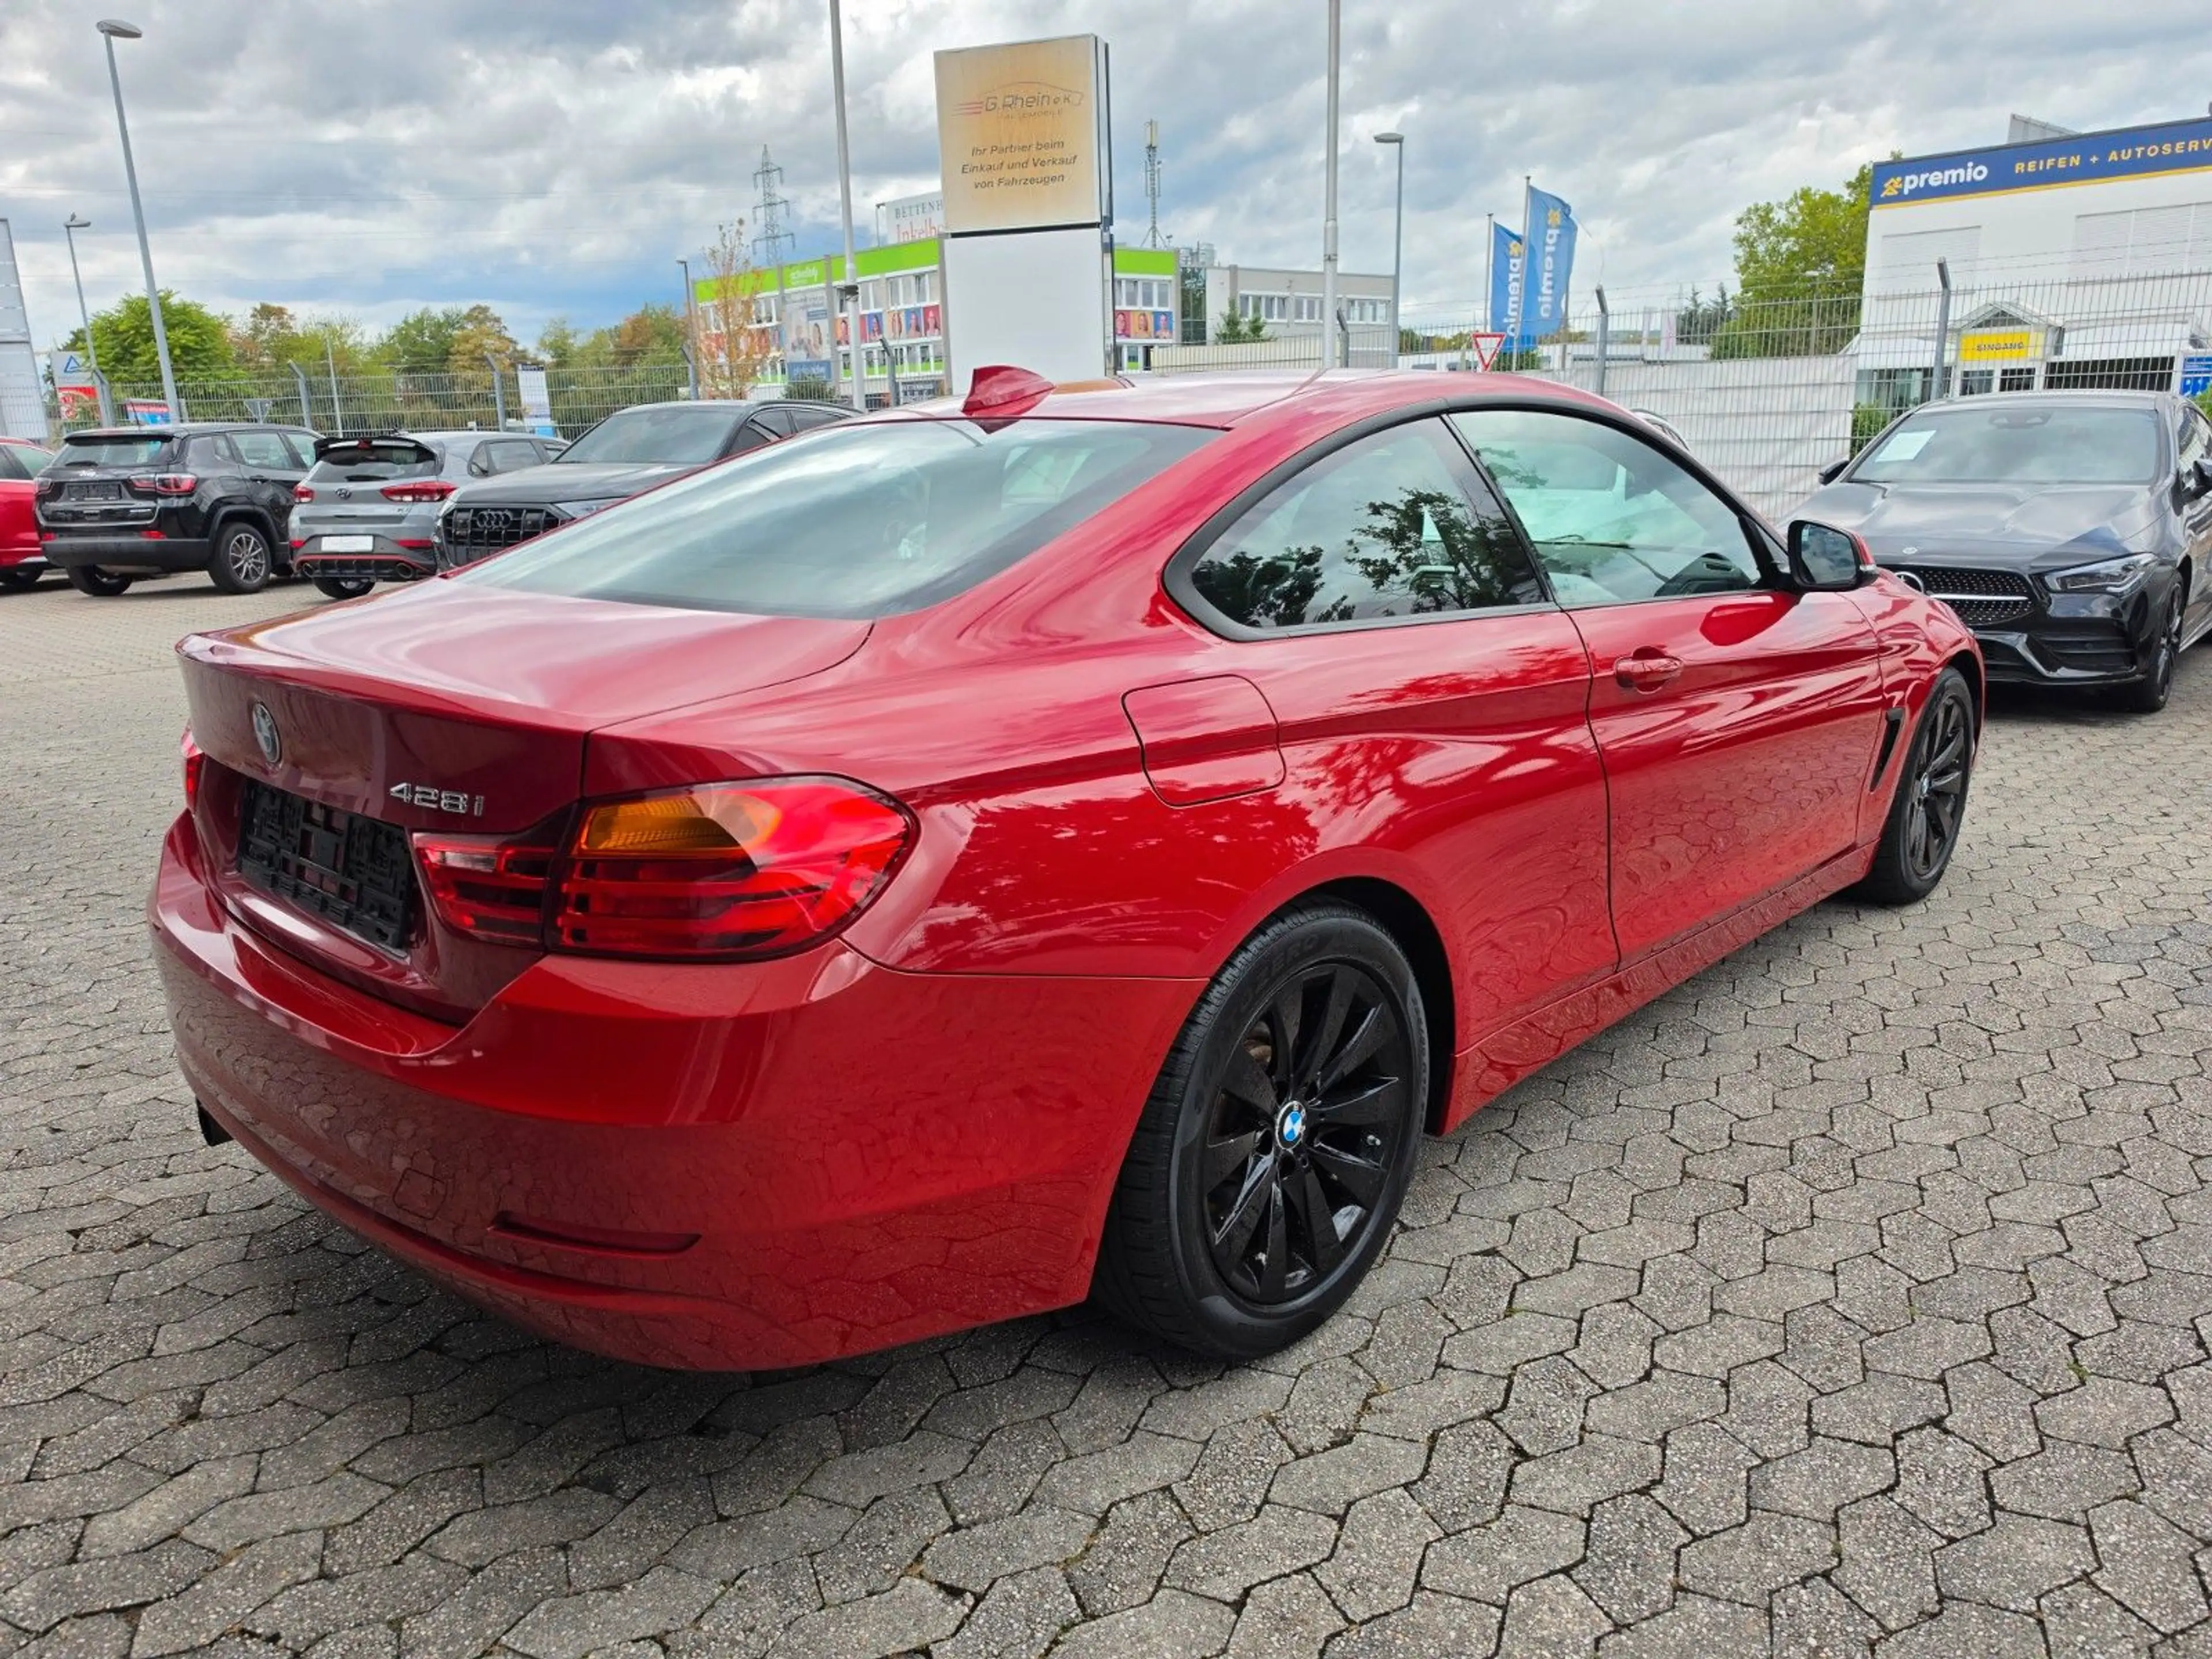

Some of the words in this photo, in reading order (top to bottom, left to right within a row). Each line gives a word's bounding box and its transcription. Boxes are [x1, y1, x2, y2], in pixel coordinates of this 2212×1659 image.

[971, 146, 987, 157] Ihr
[990, 142, 1032, 155] Partner
[1036, 139, 1065, 151] beim
[961, 161, 1005, 174] Einkauf
[1007, 158, 1028, 170] und
[1032, 154, 1078, 168] Verkauf
[1904, 162, 1988, 195] premio
[2014, 155, 2081, 174] REIFEN
[2107, 138, 2212, 162] AUTOSERV
[974, 180, 994, 190] von
[997, 174, 1065, 187] Fahrzeugen
[389, 782, 484, 817] 428i
